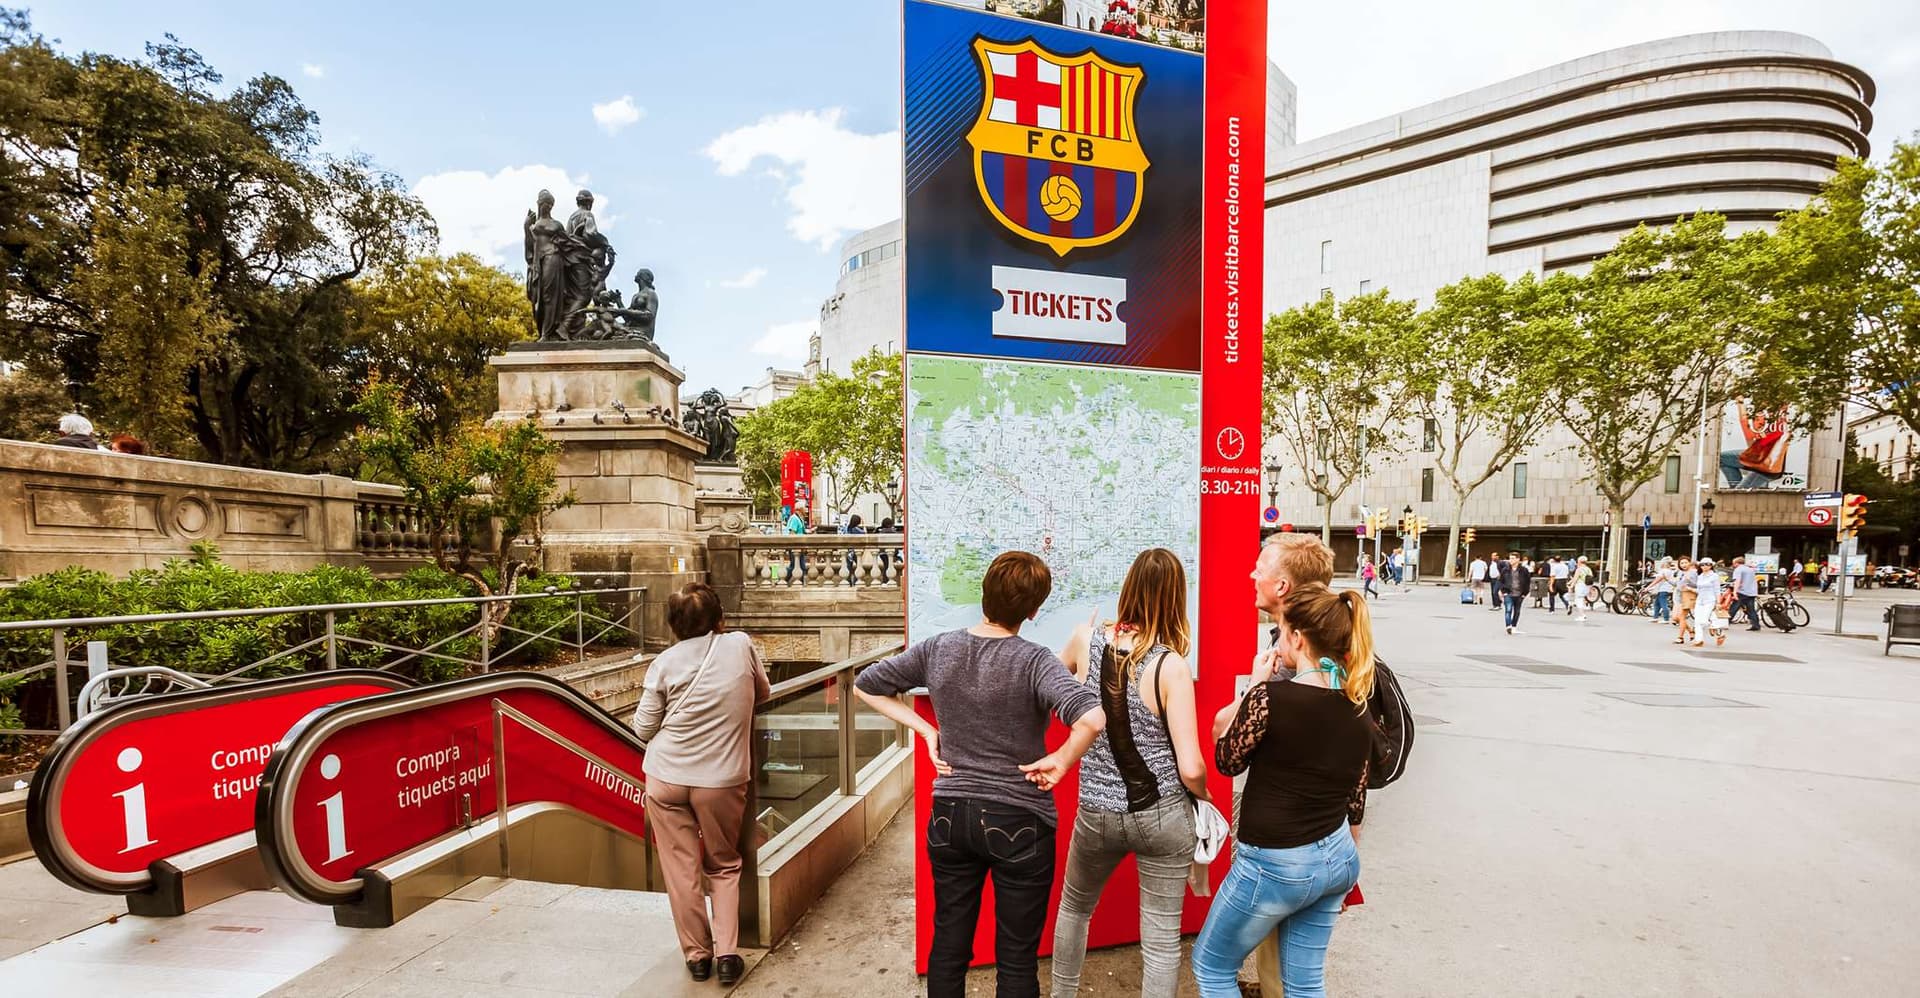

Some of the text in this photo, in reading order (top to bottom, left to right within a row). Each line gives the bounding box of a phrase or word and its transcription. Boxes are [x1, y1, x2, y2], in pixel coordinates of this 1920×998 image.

[1027, 130, 1094, 162] FCB
[1225, 116, 1240, 364] tickets.visitbarcelona.com
[1007, 289, 1113, 323] TICKETS
[1200, 466, 1216, 474] diari
[1220, 466, 1240, 474] diario
[1244, 467, 1260, 476] daily
[1200, 480, 1260, 495] 8.30-21h
[211, 741, 280, 770] Compr
[396, 745, 460, 778] Compra
[213, 772, 264, 800] tique
[398, 757, 491, 809] tiquets aquí
[585, 761, 647, 809] Informac
